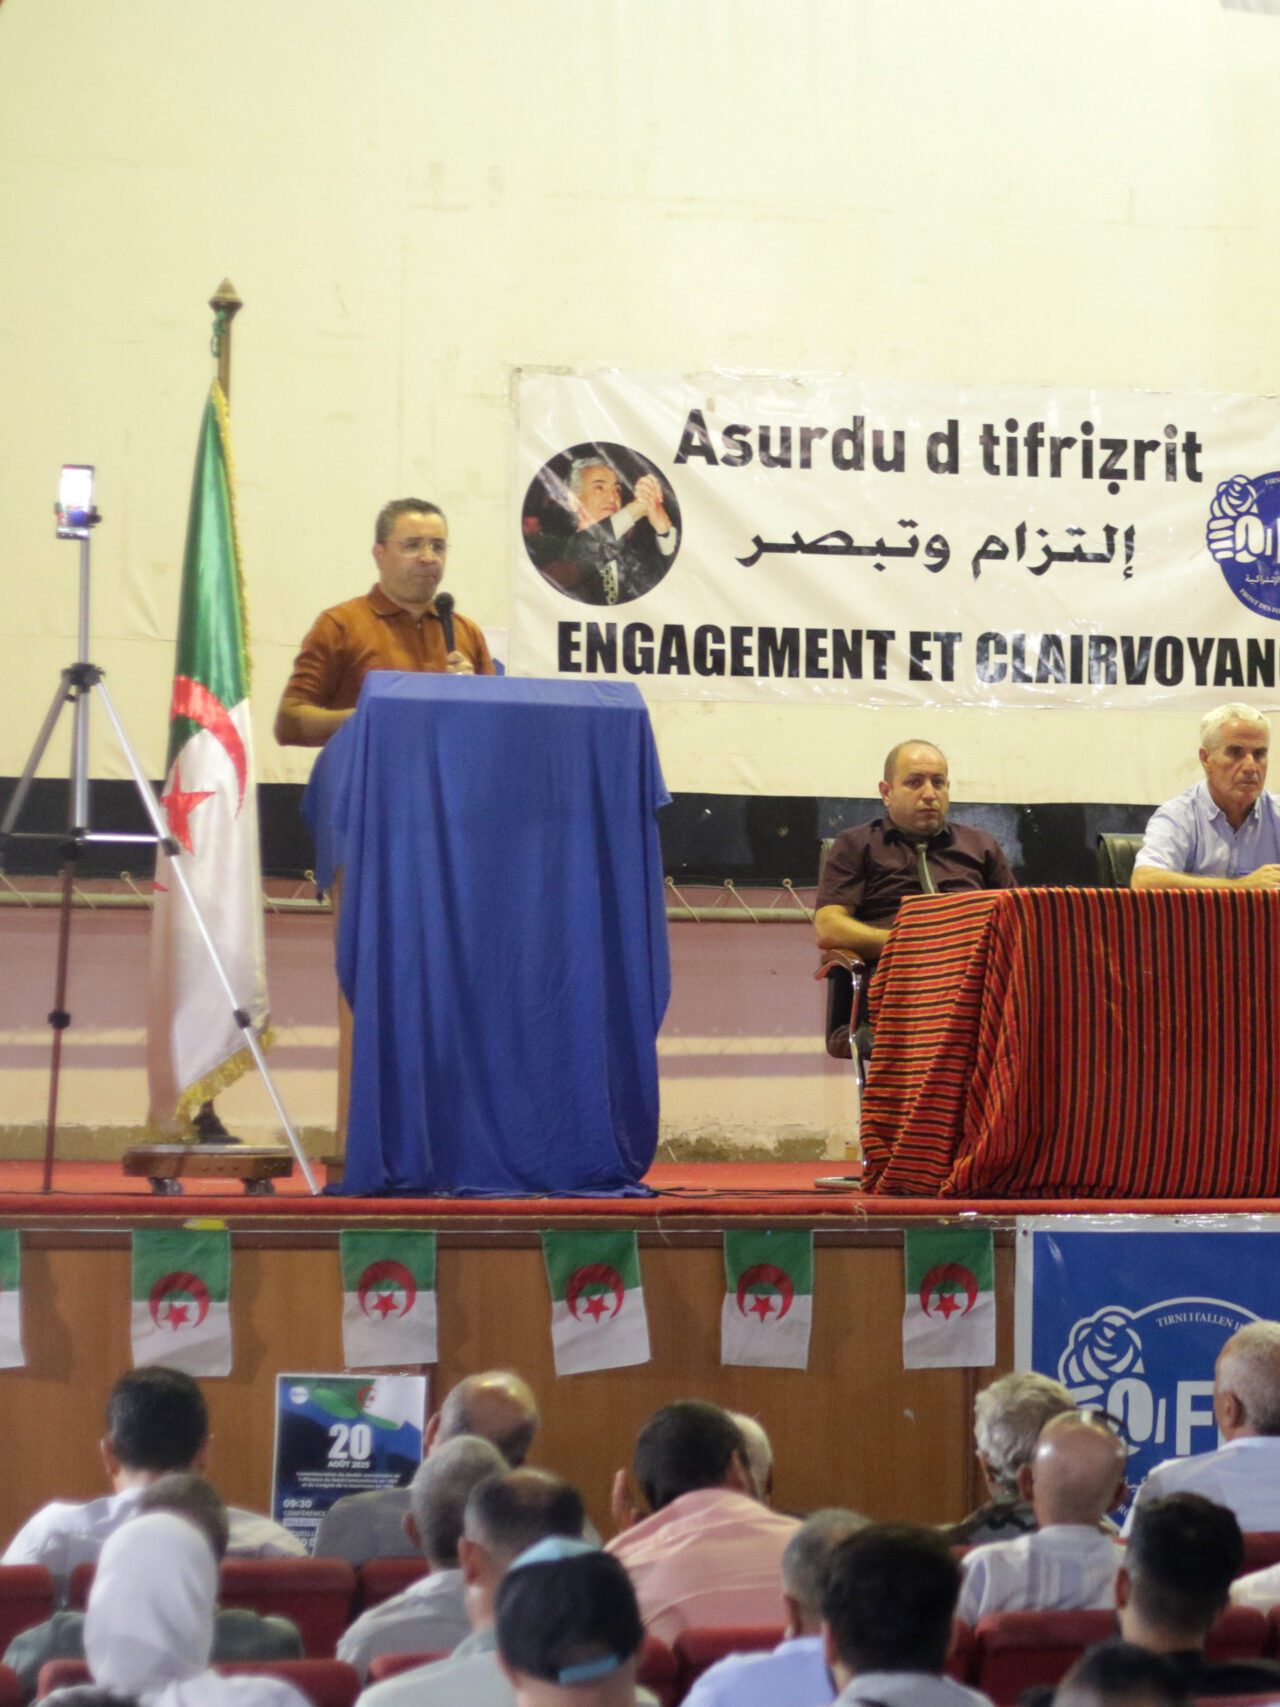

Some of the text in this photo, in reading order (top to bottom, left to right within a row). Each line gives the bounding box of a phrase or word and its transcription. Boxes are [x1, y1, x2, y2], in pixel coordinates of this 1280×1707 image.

[673, 408, 1203, 495] Asurdu d tifriẓrit
[735, 518, 1136, 582] إلتزام وتبصر
[557, 620, 896, 680] ENGAGEMENT
[908, 630, 962, 682] ET
[328, 1423, 372, 1460] 20
